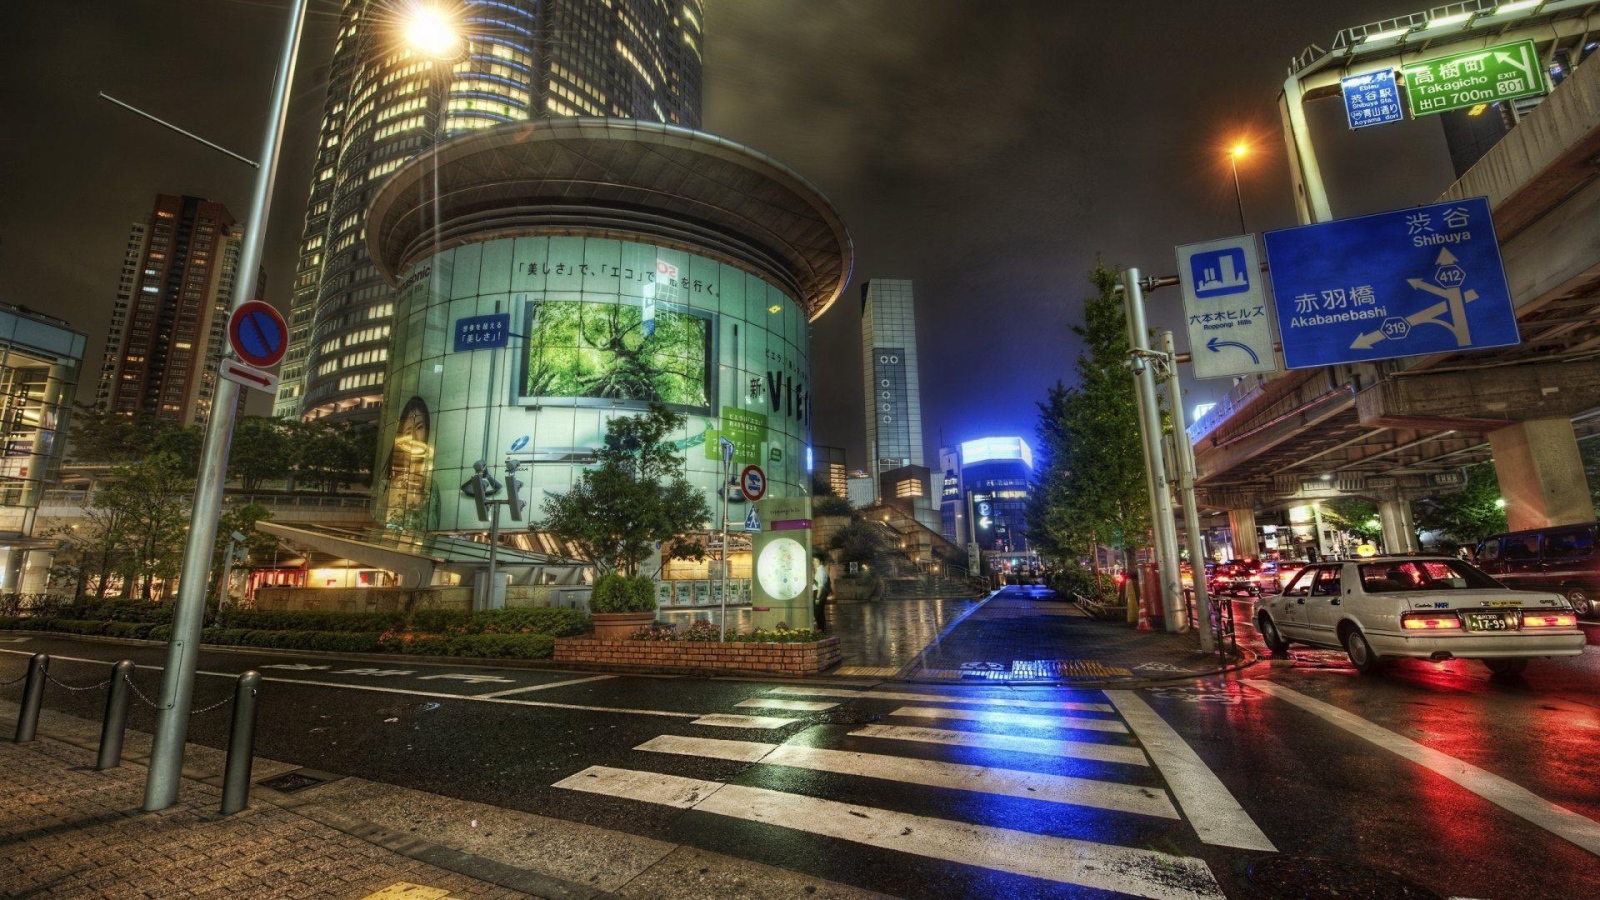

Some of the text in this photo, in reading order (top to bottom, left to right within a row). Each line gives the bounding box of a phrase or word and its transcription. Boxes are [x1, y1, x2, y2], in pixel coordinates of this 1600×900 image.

[1415, 58, 1485, 85] 高樹町
[1497, 71, 1517, 80] EXIT
[1419, 75, 1488, 95] Takagicho
[1499, 80, 1524, 95] 301
[1351, 88, 1393, 104] 渋谷駅
[1420, 89, 1493, 110] 出口 700m
[1354, 117, 1381, 125] Aoyama
[1406, 207, 1470, 235] 渋谷
[1413, 230, 1472, 248] Shibuya
[1438, 270, 1462, 283] 412
[1295, 285, 1376, 314] 赤羽橋
[1190, 305, 1265, 325] 六本木ヒルズ
[1290, 306, 1387, 328] Akabanebashi
[1203, 321, 1234, 331] Roppongi
[1384, 322, 1407, 334] 319
